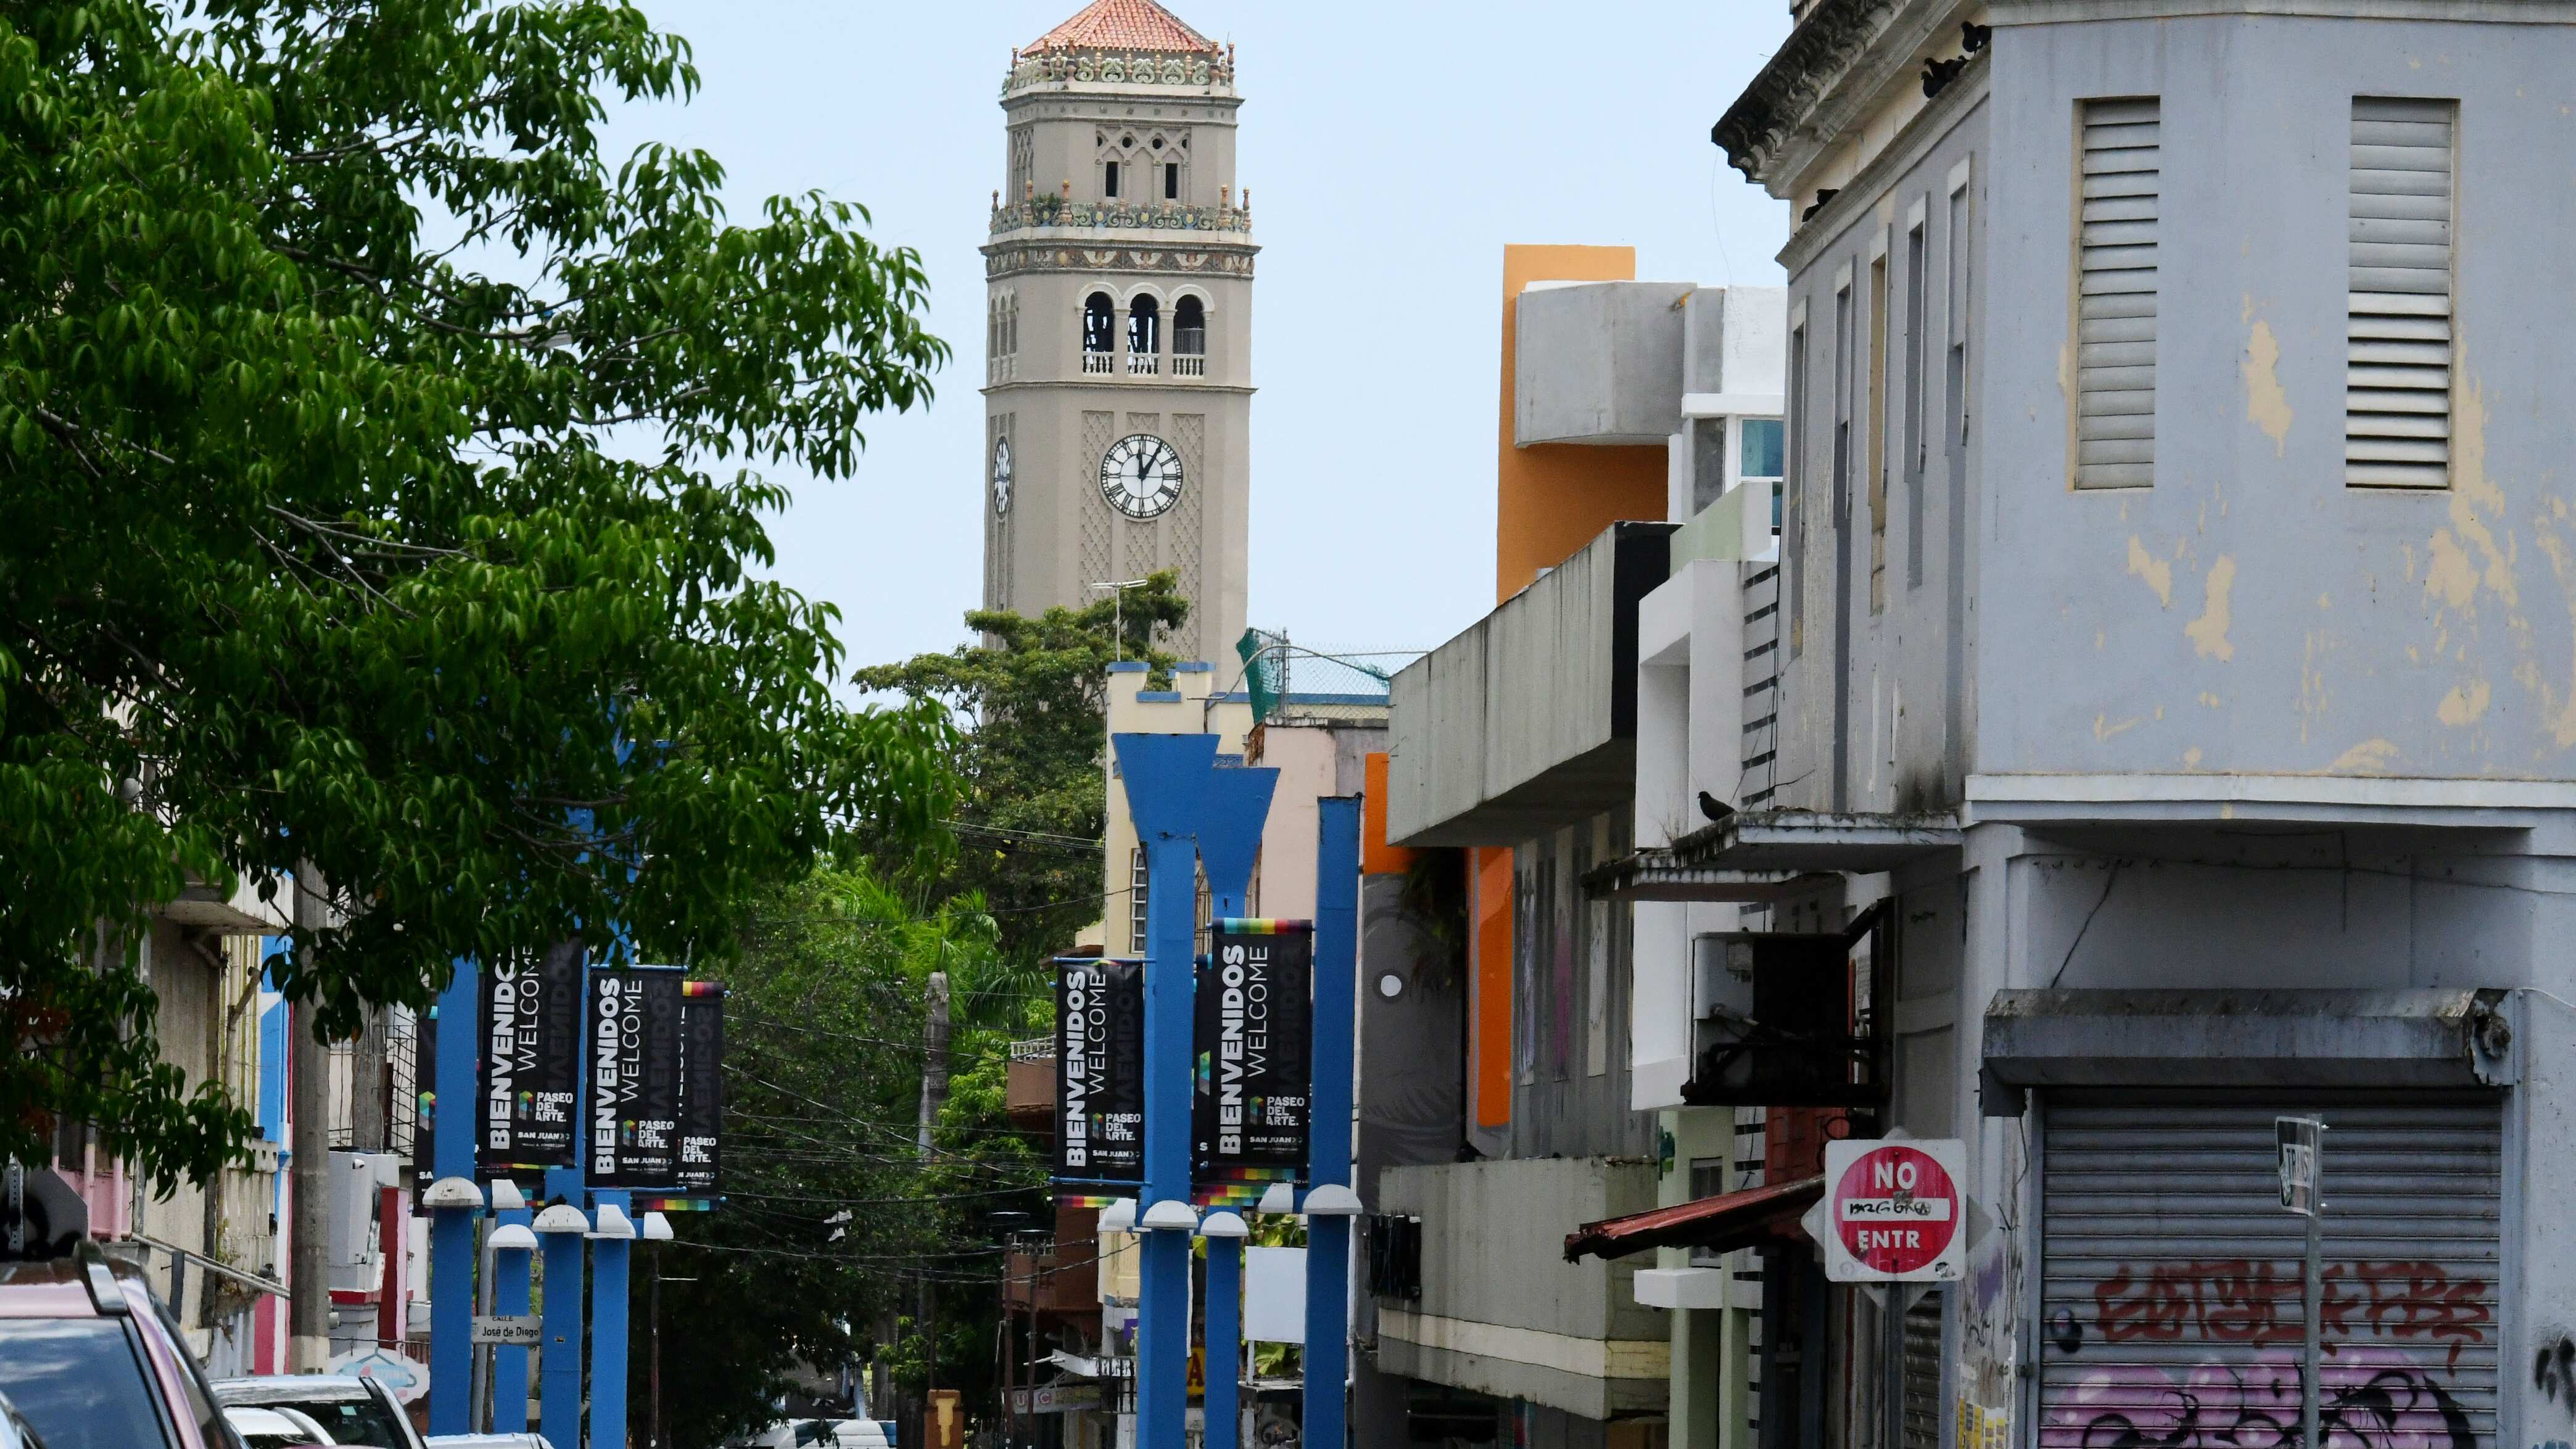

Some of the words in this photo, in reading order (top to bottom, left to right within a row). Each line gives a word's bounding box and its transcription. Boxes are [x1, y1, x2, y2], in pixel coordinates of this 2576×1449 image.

[1247, 946, 1268, 1078] WELCOME
[1089, 973, 1106, 1095] WELCOME
[621, 980, 642, 1102] WELCOME
[490, 946, 516, 1150] BIENVENIDO
[1219, 944, 1245, 1154] BIENVENIDOS
[1066, 971, 1086, 1167] BIENVENIDOS
[595, 977, 621, 1174] BIENVENIDOS
[537, 1091, 574, 1104] PASEO
[1266, 1096, 1305, 1107] PASEO
[536, 1102, 558, 1112] DEL
[1266, 1106, 1290, 1116] DEL
[535, 1112, 567, 1122] ARTE.
[1105, 1113, 1141, 1123] PASEO
[1266, 1115, 1299, 1126] ARTE.
[638, 1120, 675, 1130] PASEO
[1105, 1123, 1127, 1132] DEL
[638, 1130, 660, 1139] DEL
[1105, 1131, 1136, 1141] ARTE.
[638, 1139, 669, 1149] ARTE.
[683, 1137, 717, 1147] PASEO
[683, 1146, 703, 1154] DEL
[682, 1154, 711, 1163] ARTE.
[1875, 1162, 1917, 1189] NO
[1857, 1230, 1920, 1250] ENTR
[482, 1326, 502, 1337] José
[503, 1326, 514, 1337] de
[516, 1326, 539, 1338] Diego
